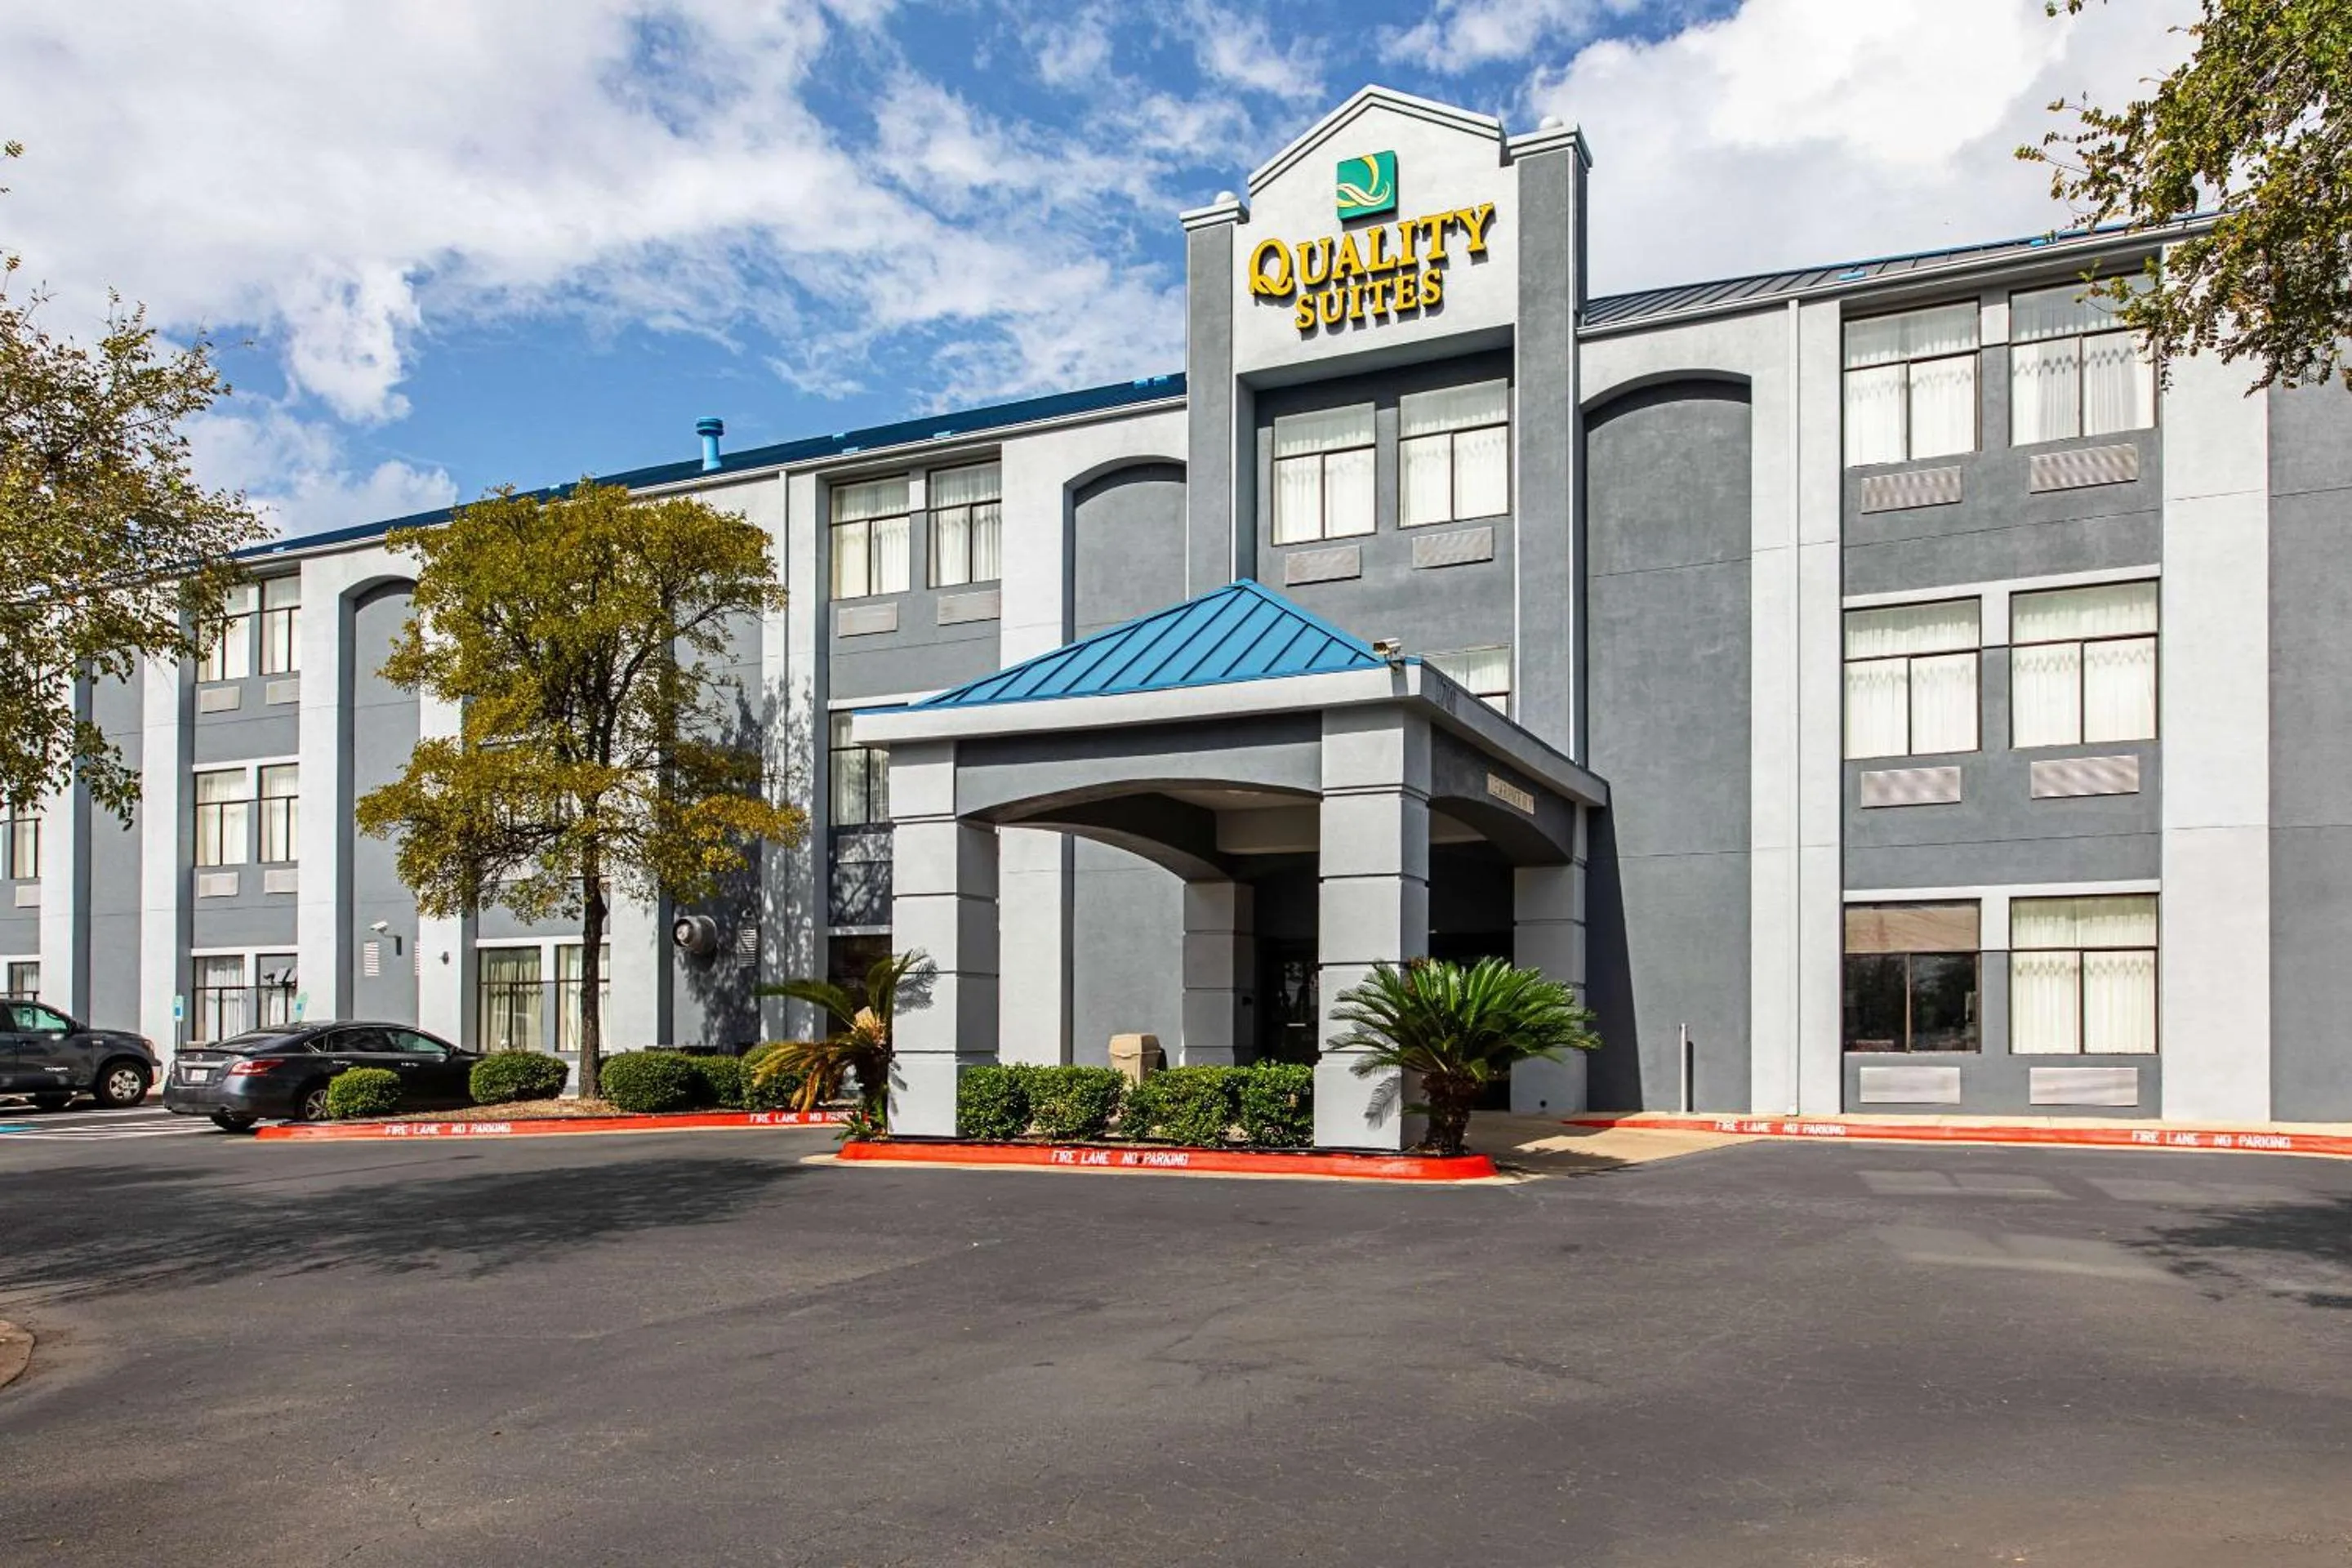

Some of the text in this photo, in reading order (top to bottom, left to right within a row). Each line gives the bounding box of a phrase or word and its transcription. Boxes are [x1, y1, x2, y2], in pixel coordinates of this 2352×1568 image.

[1249, 202, 1495, 296] QUALITY
[1294, 267, 1442, 330] SUITES
[775, 1111, 799, 1123] LANE
[808, 1112, 822, 1121] NO
[413, 1123, 441, 1134] LANE
[451, 1123, 466, 1134] NO
[470, 1122, 510, 1133] PARKING
[1743, 1122, 1770, 1133] LANE
[1783, 1124, 1798, 1134] NO
[1802, 1124, 1846, 1135] PARKING
[2132, 1130, 2292, 1148] FIRE LANE NO PARKING
[1051, 1150, 1189, 1165] FIRE LANE NO PARKING
